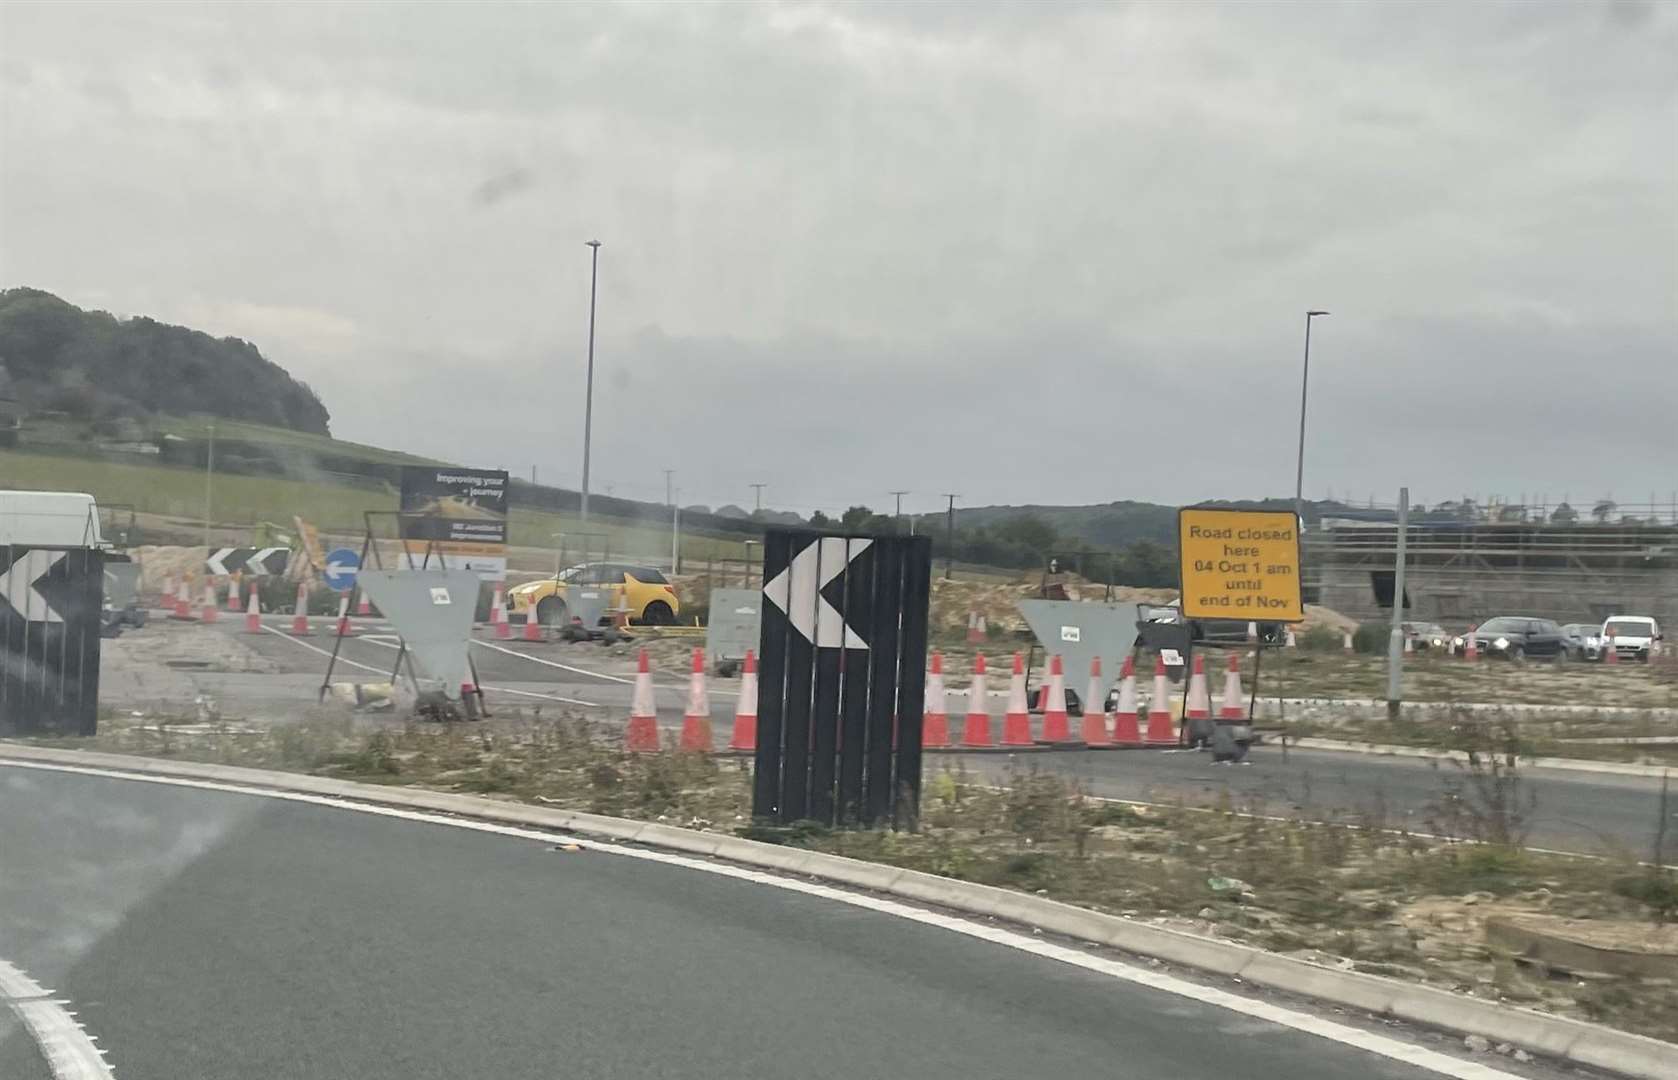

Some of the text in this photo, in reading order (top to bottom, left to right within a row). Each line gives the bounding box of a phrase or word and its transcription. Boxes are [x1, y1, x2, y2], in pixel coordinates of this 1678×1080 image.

[437, 474, 504, 486] Improving your
[470, 487, 504, 498] journey
[1190, 526, 1292, 541] Road closed
[1224, 545, 1260, 557] here
[1194, 560, 1291, 574] 04 Oct 1 am
[1226, 579, 1262, 590] until
[1199, 596, 1288, 608] end of Nov
